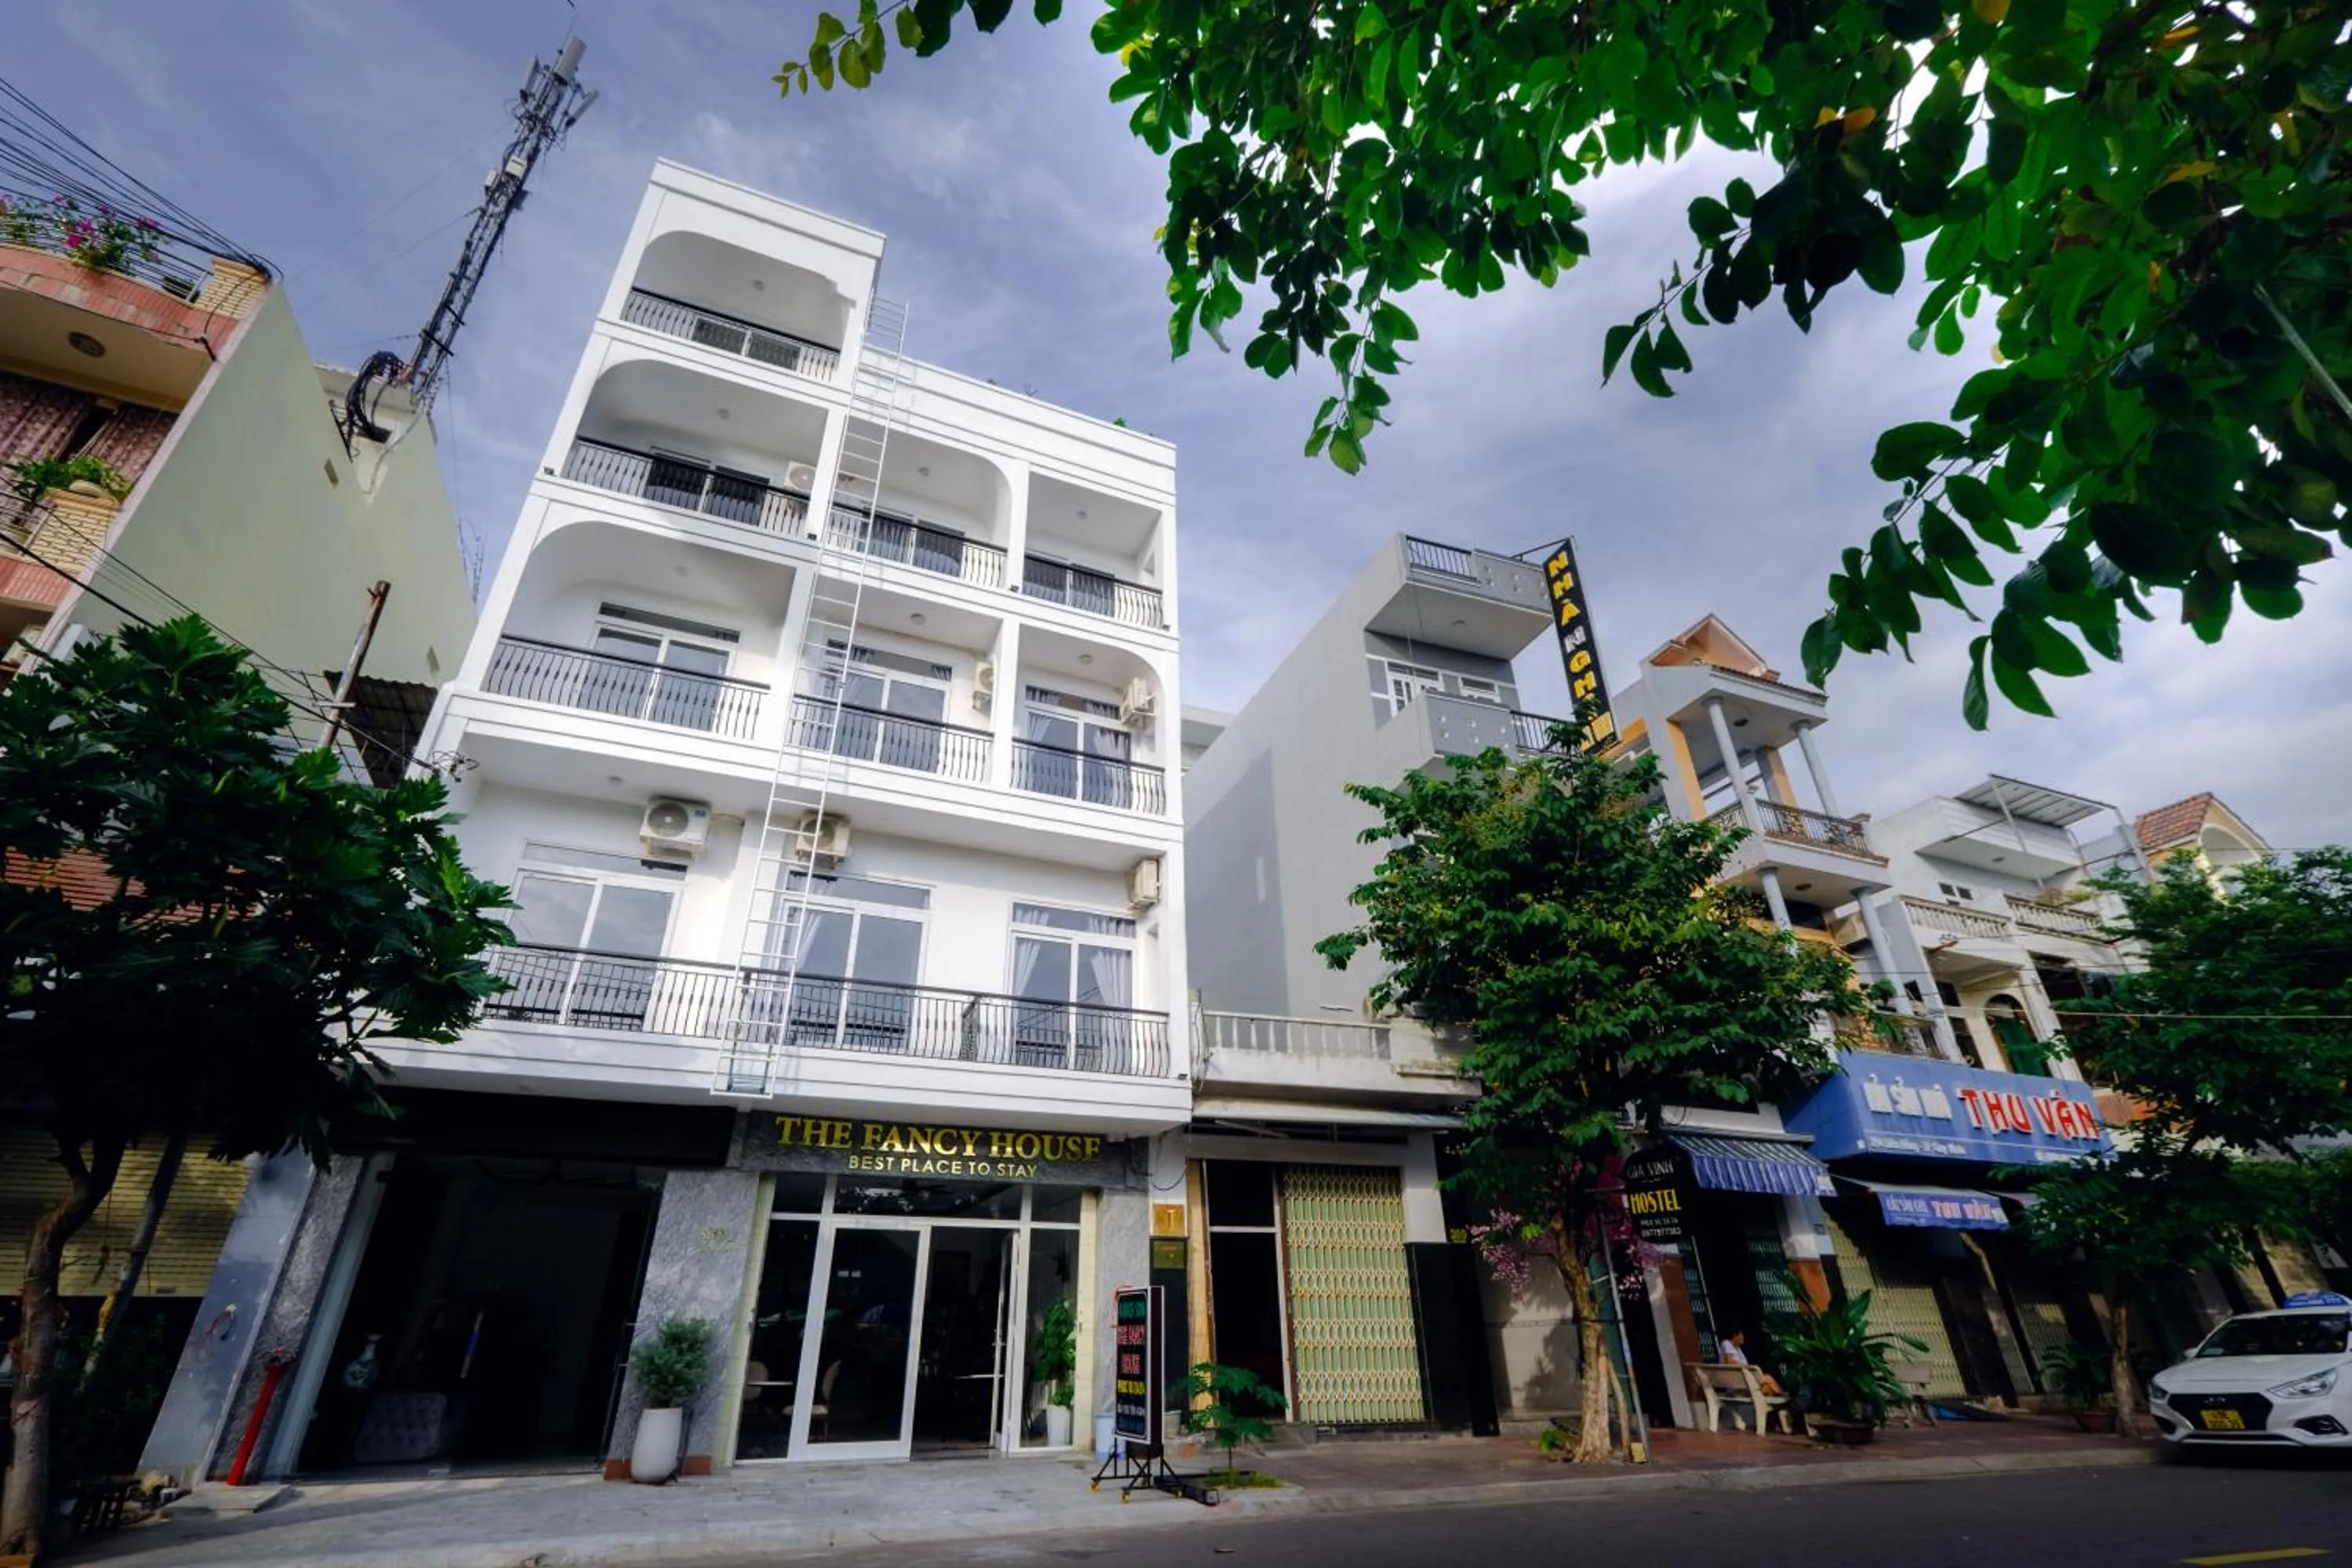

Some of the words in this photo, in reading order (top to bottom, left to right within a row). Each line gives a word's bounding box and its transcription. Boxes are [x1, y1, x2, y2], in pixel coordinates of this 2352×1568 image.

[1548, 551, 1581, 626] NHÀ
[1565, 626, 1597, 710] NGH
[1957, 1087, 2033, 1134] THU
[2027, 1089, 2101, 1141] VÂN
[775, 1116, 852, 1149] THE
[860, 1123, 982, 1156] FANCY
[989, 1131, 1102, 1161] HOUSE
[848, 1155, 895, 1171] BEST
[901, 1158, 962, 1174] PLACE
[968, 1161, 990, 1175] TO
[997, 1163, 1037, 1178] STAY
[1631, 1189, 1681, 1214] HOSTEL
